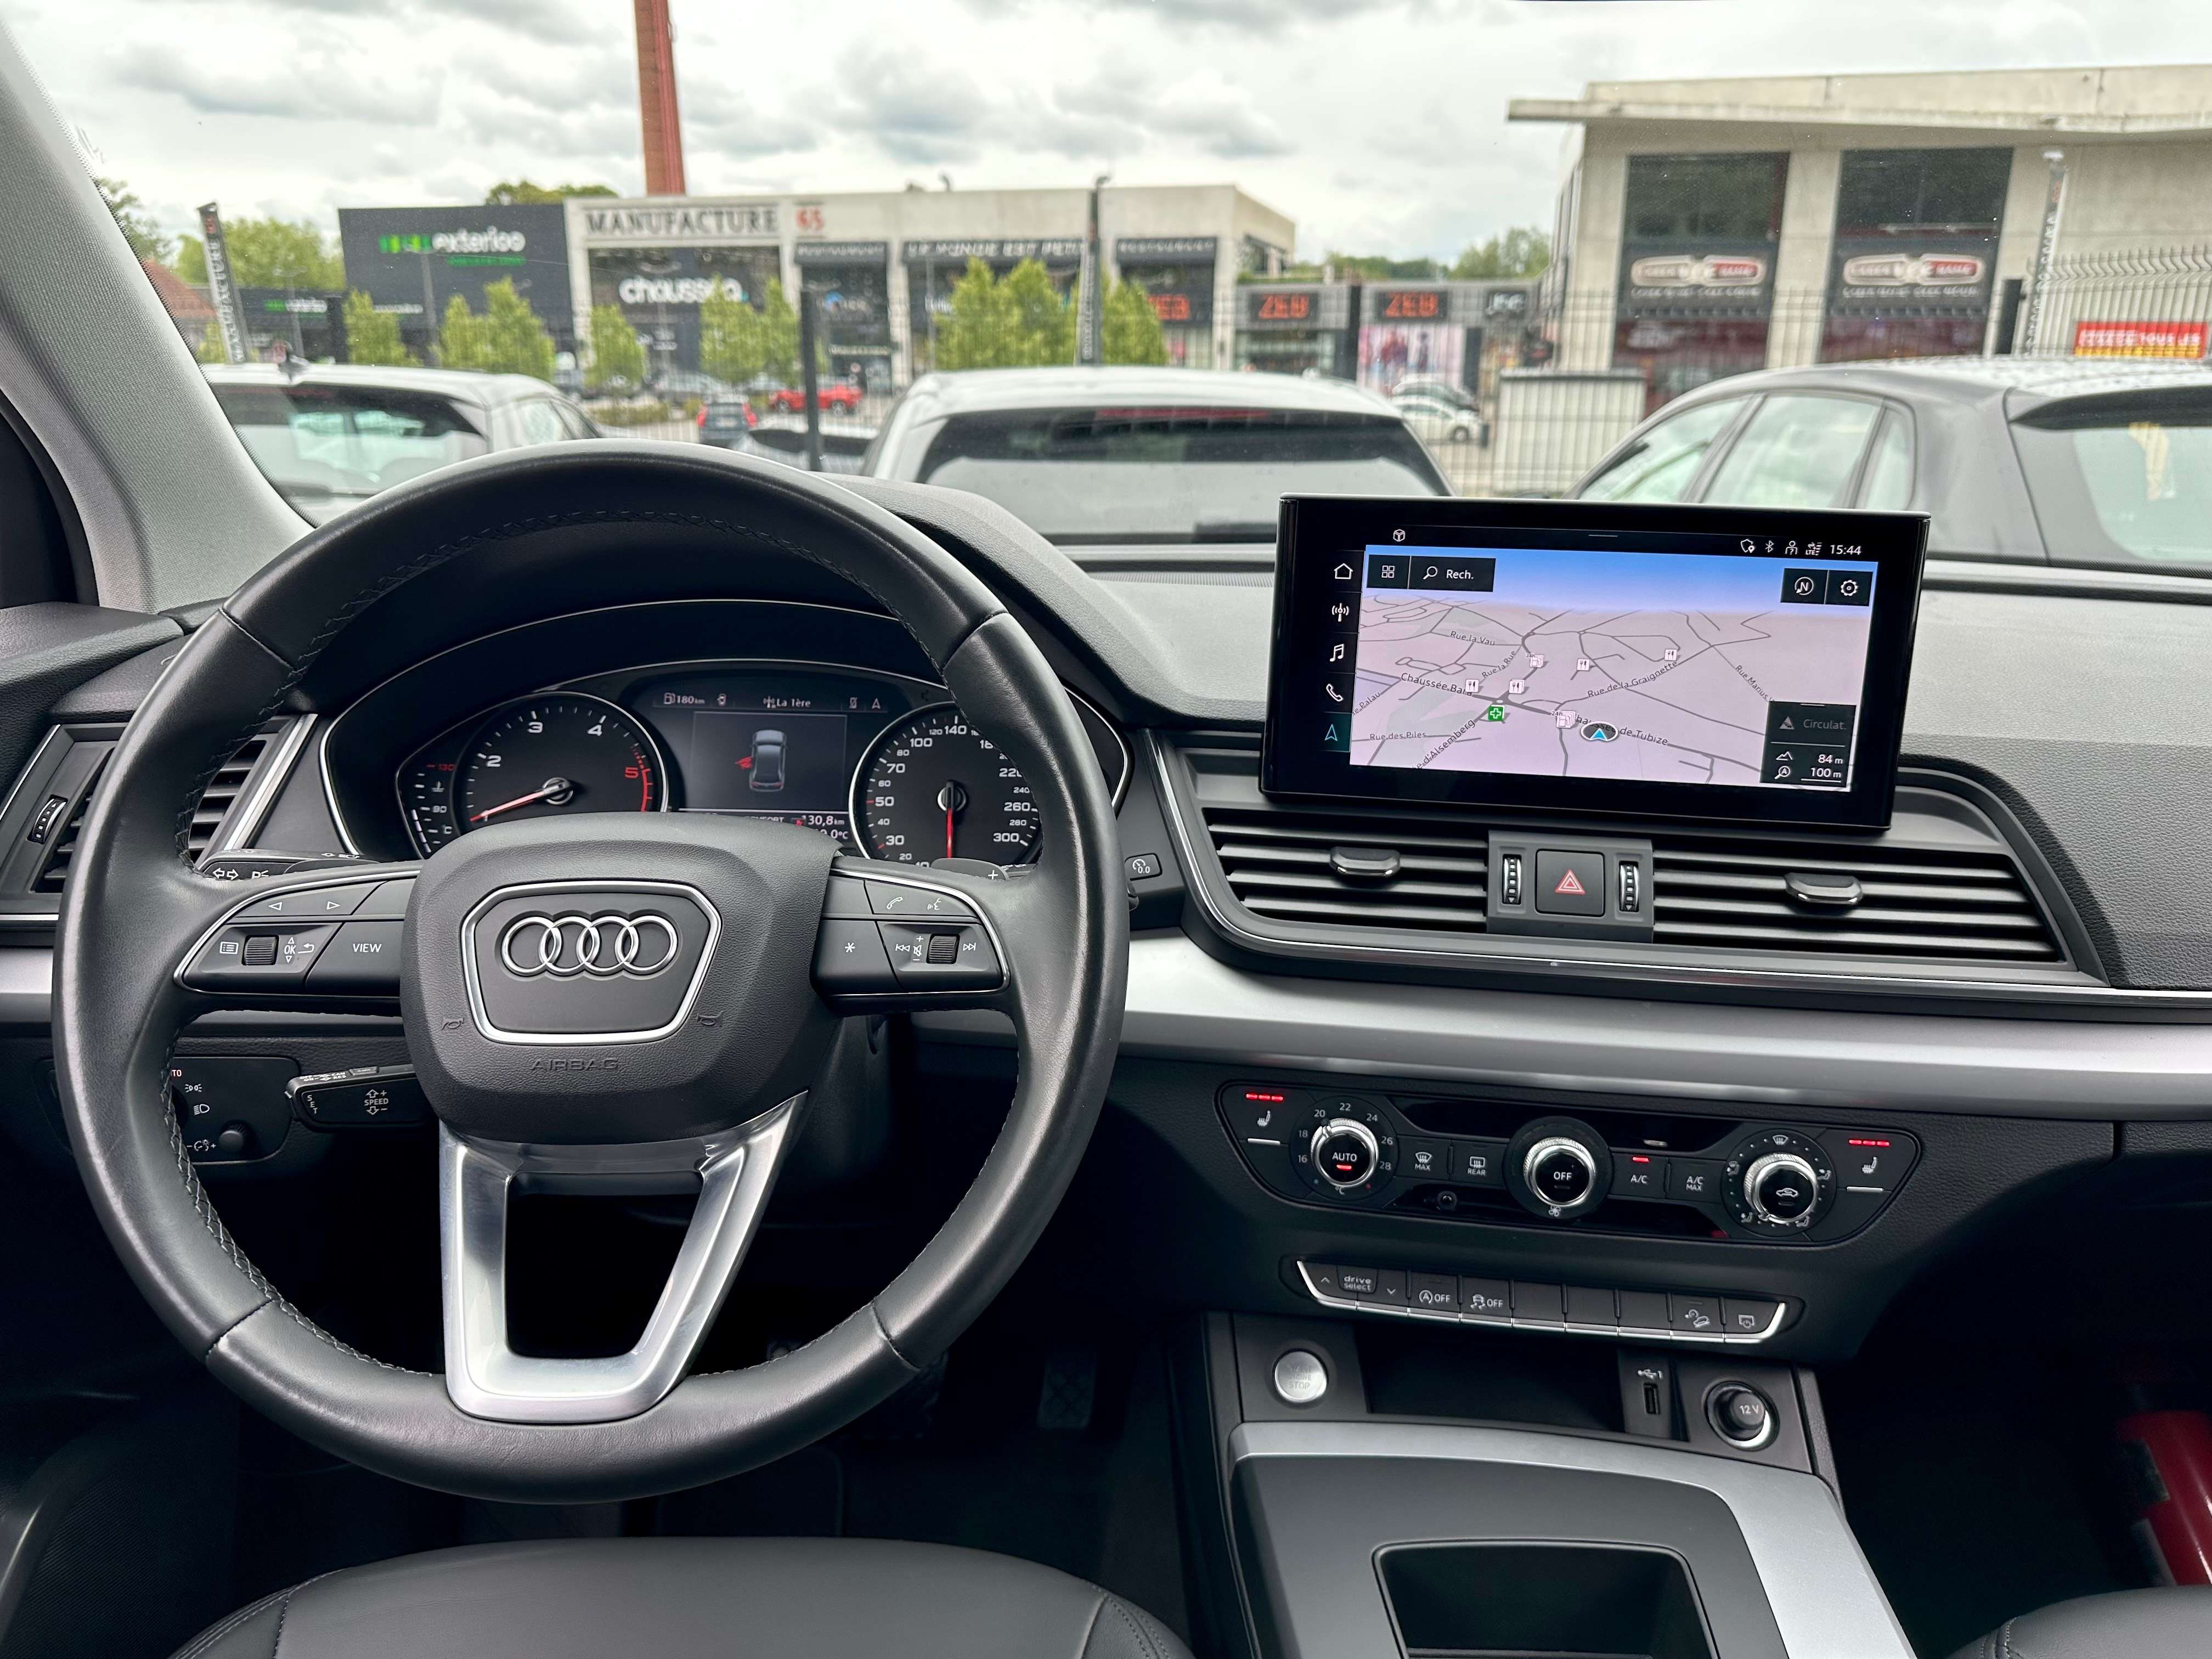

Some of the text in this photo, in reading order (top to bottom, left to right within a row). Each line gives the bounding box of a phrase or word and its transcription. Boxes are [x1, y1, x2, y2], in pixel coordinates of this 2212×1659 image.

[587, 207, 778, 235] MANUFACTURE
[1258, 294, 1310, 320] ZEB
[1384, 291, 1440, 318] ZEB
[1830, 544, 1861, 555] 15:44
[1446, 568, 1474, 580] Rech.
[1450, 631, 1467, 641] Rue
[1480, 636, 1496, 646] Vau
[1481, 667, 1498, 678] Rue
[1503, 650, 1516, 664] Rue
[1631, 661, 1678, 686] Graignette
[1401, 673, 1448, 691] Chaussée
[1735, 665, 1768, 699] Rue Marius
[776, 698, 811, 707] La 1ère
[1359, 692, 1381, 709] Palau
[527, 721, 543, 734] 3
[1803, 719, 1847, 730] Circulat.
[588, 724, 602, 737] 4
[944, 725, 967, 735] 140
[1620, 726, 1633, 736] de
[1635, 730, 1668, 746] Tubize
[910, 738, 933, 747] 100
[1423, 719, 1476, 764] d'Alsemberg
[487, 755, 501, 767] 2
[1818, 754, 1832, 764] 84
[624, 767, 639, 778] 5
[887, 763, 906, 774] 70
[1810, 768, 1831, 778] 100
[875, 797, 895, 807] 50
[1003, 802, 1031, 812] 260
[885, 836, 905, 845] 30
[993, 832, 1019, 842] 300
[1138, 866, 1150, 874] 0.0
[284, 945, 296, 955] OK
[352, 943, 382, 953] VIEW
[530, 1057, 620, 1072] AIRBAG
[364, 1098, 389, 1106] SPEED
[1339, 1103, 1352, 1111] 22
[1314, 1109, 1326, 1118] 20
[1366, 1113, 1378, 1122] 24
[1298, 1130, 1308, 1138] 18
[1380, 1136, 1393, 1146] 26
[1298, 1155, 1308, 1163] 16
[1332, 1152, 1357, 1162] AUTO
[1379, 1161, 1392, 1171] 28
[1414, 1163, 1431, 1171] MAX
[1467, 1167, 1486, 1176] REAR
[1553, 1171, 1572, 1181] OFF
[1630, 1174, 1649, 1184] A/C
[1686, 1175, 1704, 1186] A/C
[1686, 1184, 1702, 1192] MAX
[1344, 1275, 1372, 1285] drive
[1344, 1283, 1372, 1292] select
[1434, 1294, 1451, 1304] OFF
[1486, 1299, 1504, 1308] OFF
[1739, 1404, 1760, 1414] 12 V
